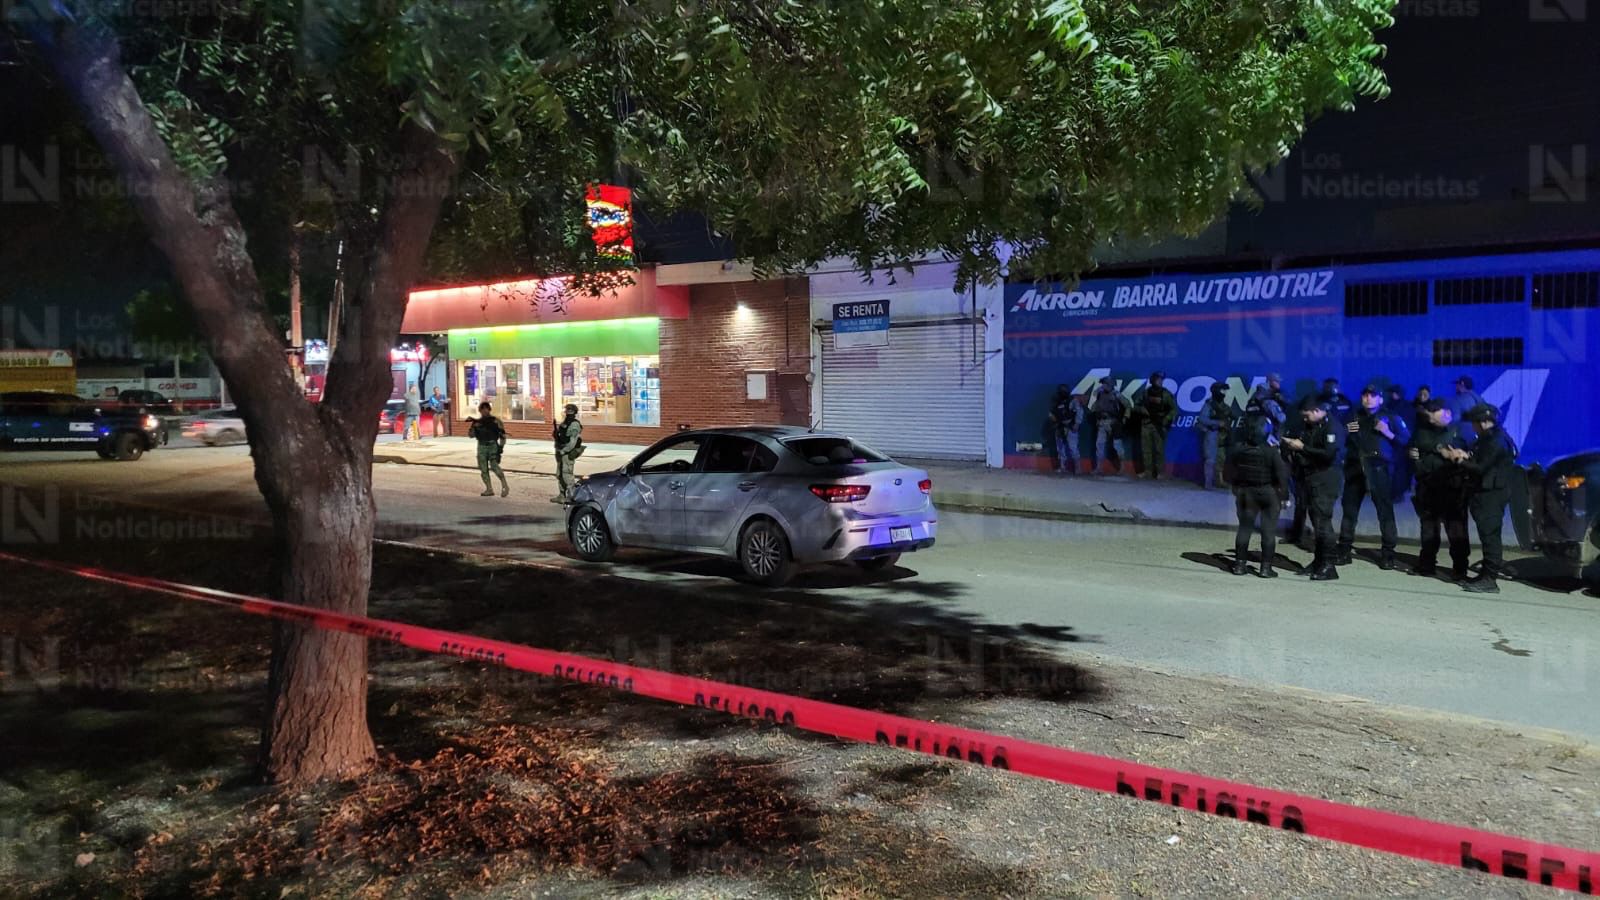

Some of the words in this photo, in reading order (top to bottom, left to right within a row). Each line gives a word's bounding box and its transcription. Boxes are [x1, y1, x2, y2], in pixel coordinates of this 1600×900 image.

[1011, 289, 1105, 312] AKRON
[1112, 283, 1177, 309] IBARRA
[1183, 271, 1334, 305] AUTOMOTRIZ
[838, 306, 851, 318] SE
[852, 303, 884, 316] RENTA
